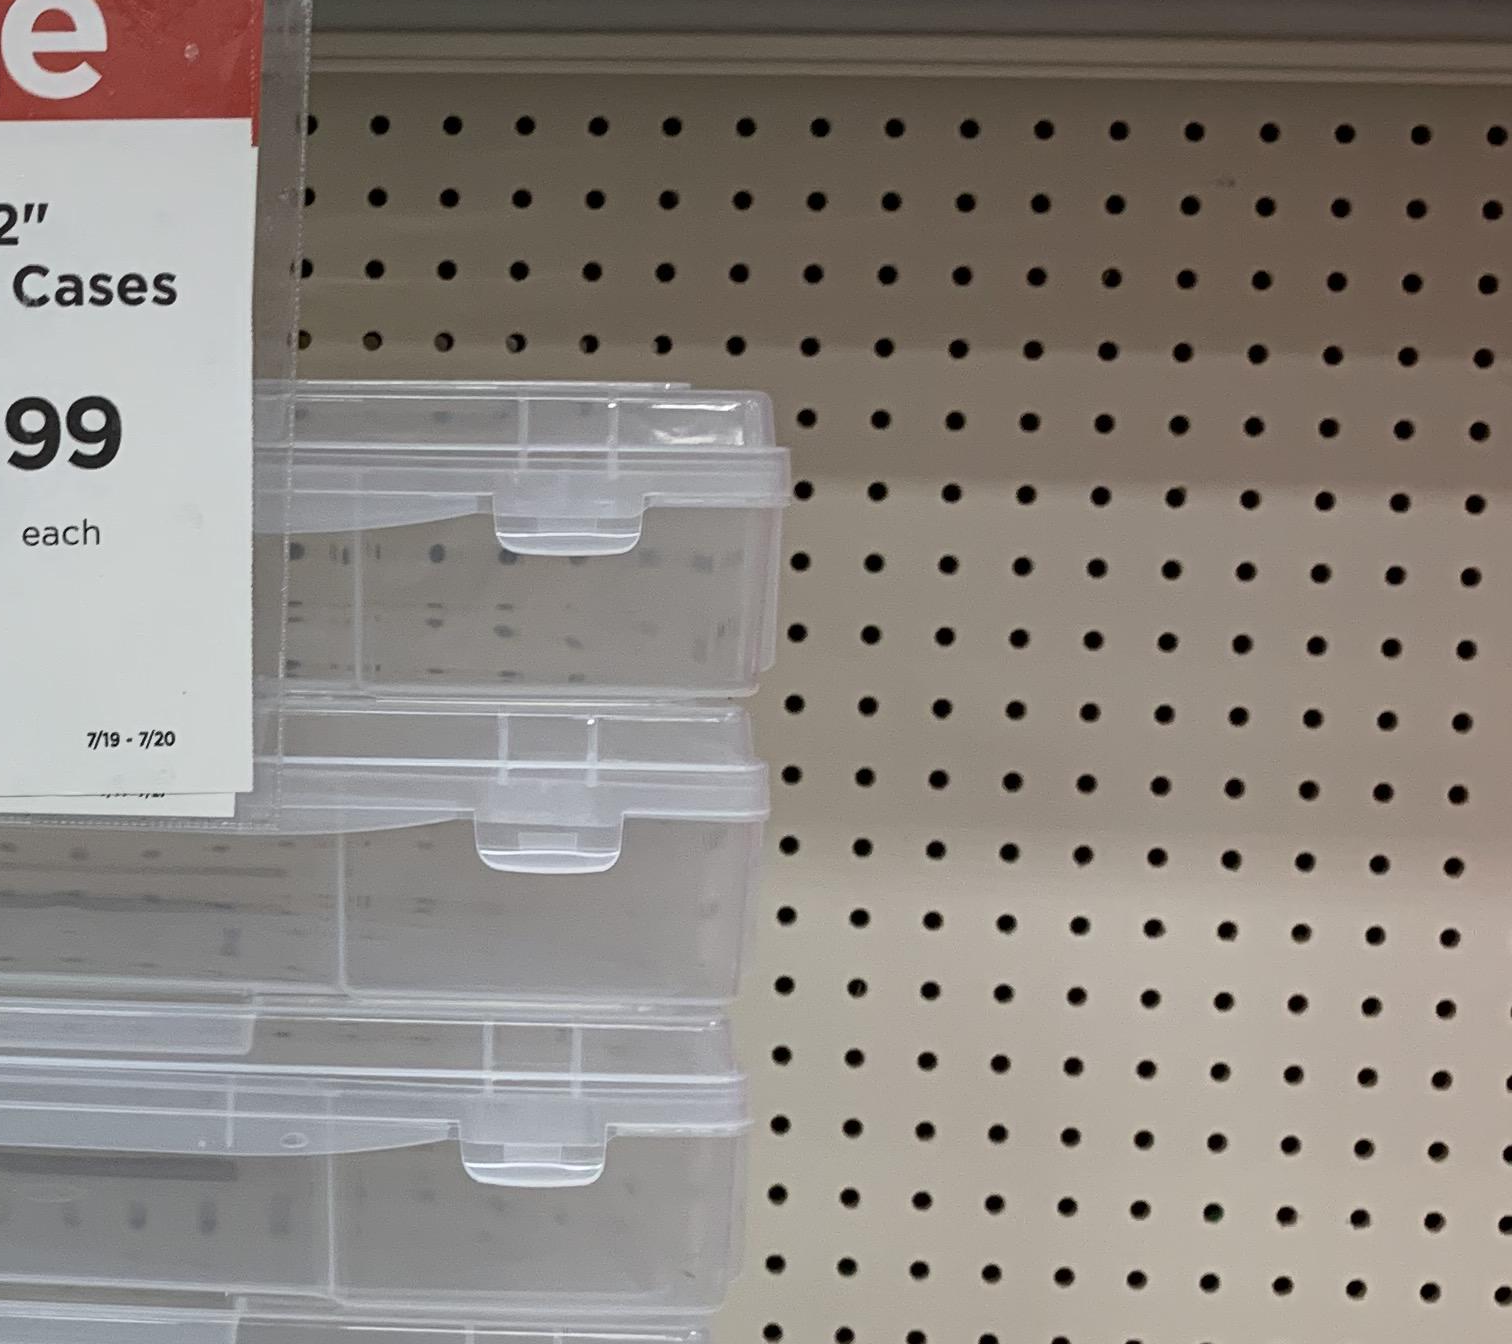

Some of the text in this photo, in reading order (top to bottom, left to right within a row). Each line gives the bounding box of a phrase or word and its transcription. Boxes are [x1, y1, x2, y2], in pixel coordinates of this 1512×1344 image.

[12, 264, 179, 307] Cases
[21, 519, 102, 548] each
[86, 731, 121, 749] 7/19
[138, 730, 176, 748] 7/20
